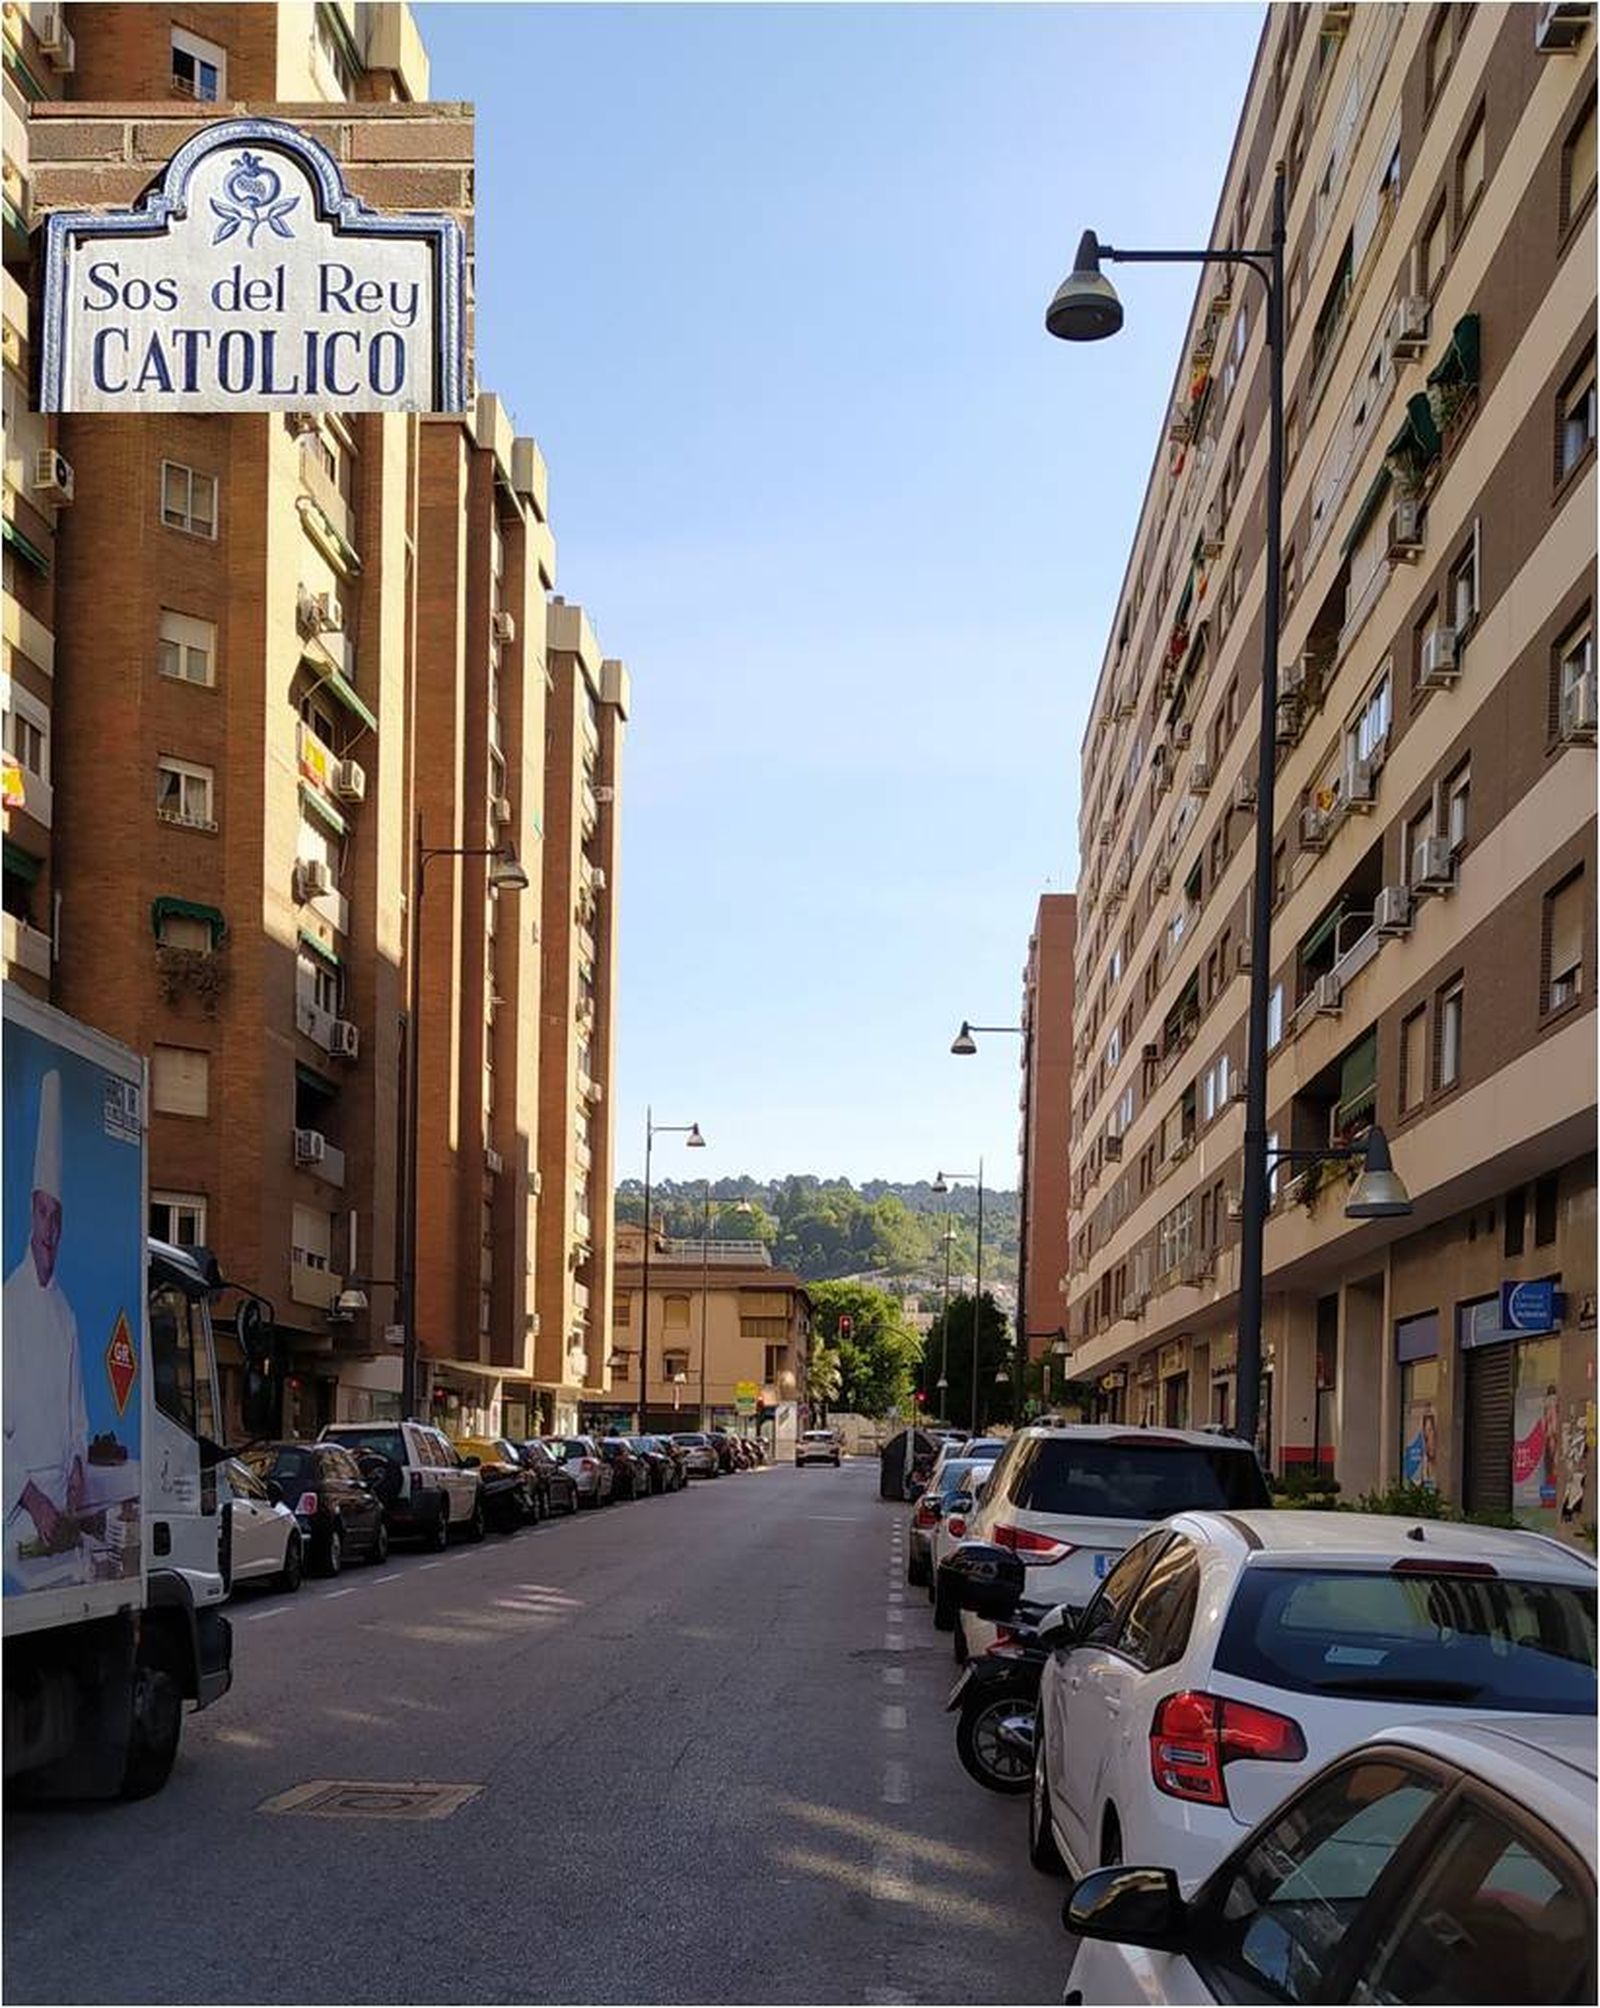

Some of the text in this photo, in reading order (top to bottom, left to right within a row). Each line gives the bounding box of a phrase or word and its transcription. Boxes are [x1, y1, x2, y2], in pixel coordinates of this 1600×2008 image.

[83, 263, 420, 328] Sos del Rey
[93, 327, 403, 396] CATOLICO
